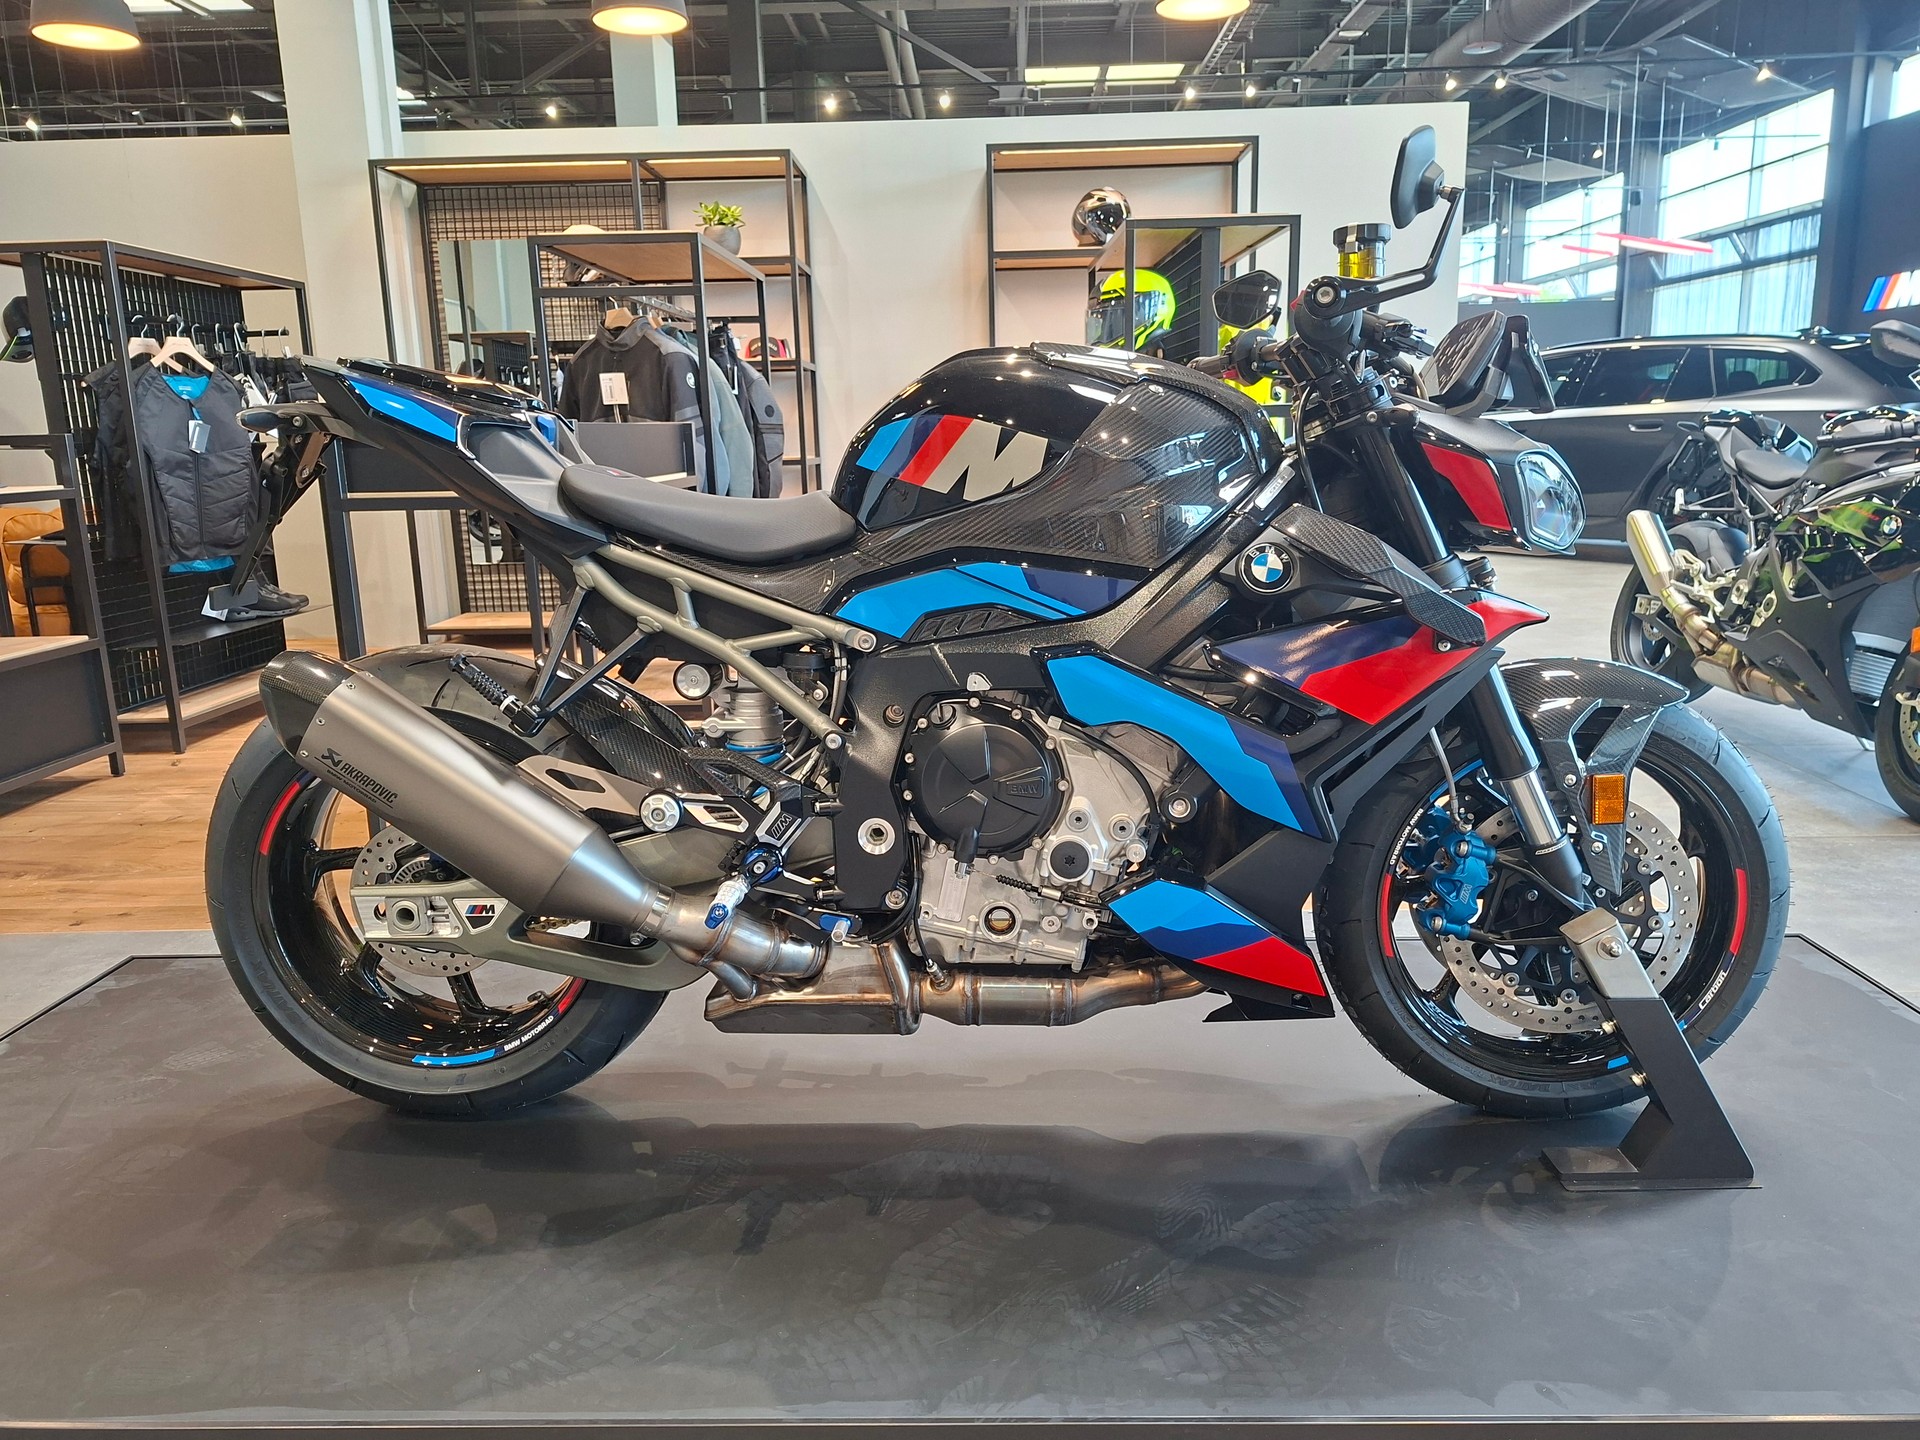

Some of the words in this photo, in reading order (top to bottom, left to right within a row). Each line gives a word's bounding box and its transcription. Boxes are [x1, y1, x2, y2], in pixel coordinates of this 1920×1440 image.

[922, 418, 1048, 501] M
[1009, 784, 1039, 794] BMW
[1409, 808, 1424, 826] BMW
[1390, 826, 1411, 865] MOTORRAD
[1698, 970, 1728, 1010] Carbon
[503, 1038, 520, 1051] BMW
[521, 1015, 554, 1042] MOTORRAD
